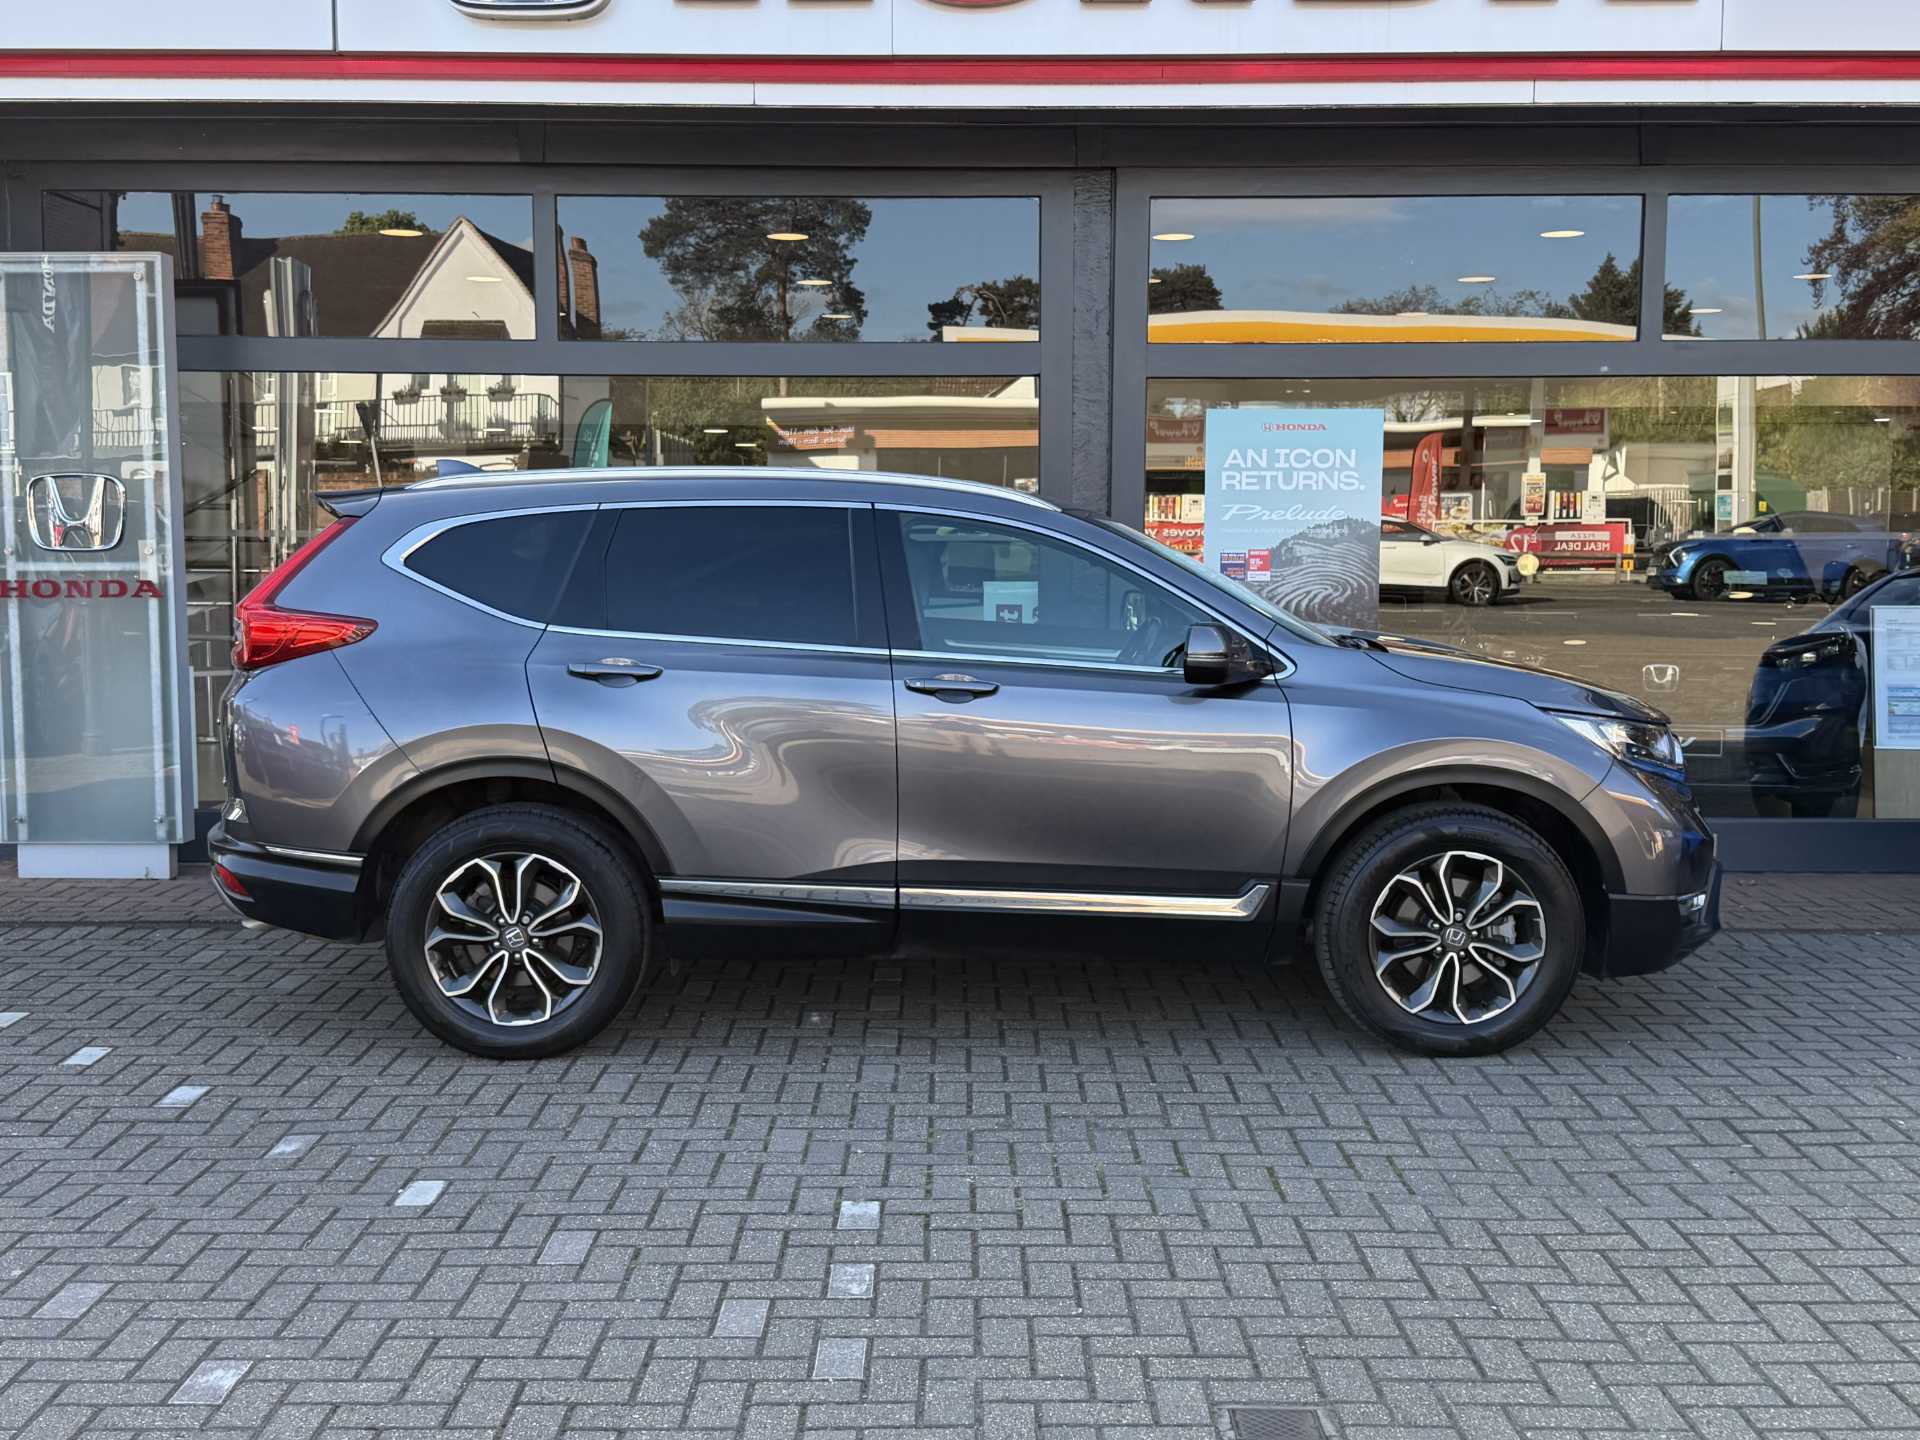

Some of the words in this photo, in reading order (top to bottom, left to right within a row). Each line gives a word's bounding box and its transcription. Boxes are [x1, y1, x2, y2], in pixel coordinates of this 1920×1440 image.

[1276, 423, 1328, 431] HONDA
[1223, 449, 1267, 468] AN
[1274, 449, 1356, 468] ICON
[1221, 471, 1366, 491] RETURNS.
[1427, 456, 1439, 524] V-Power
[1221, 504, 1346, 521] Prelude
[0, 579, 164, 599] HONDA
